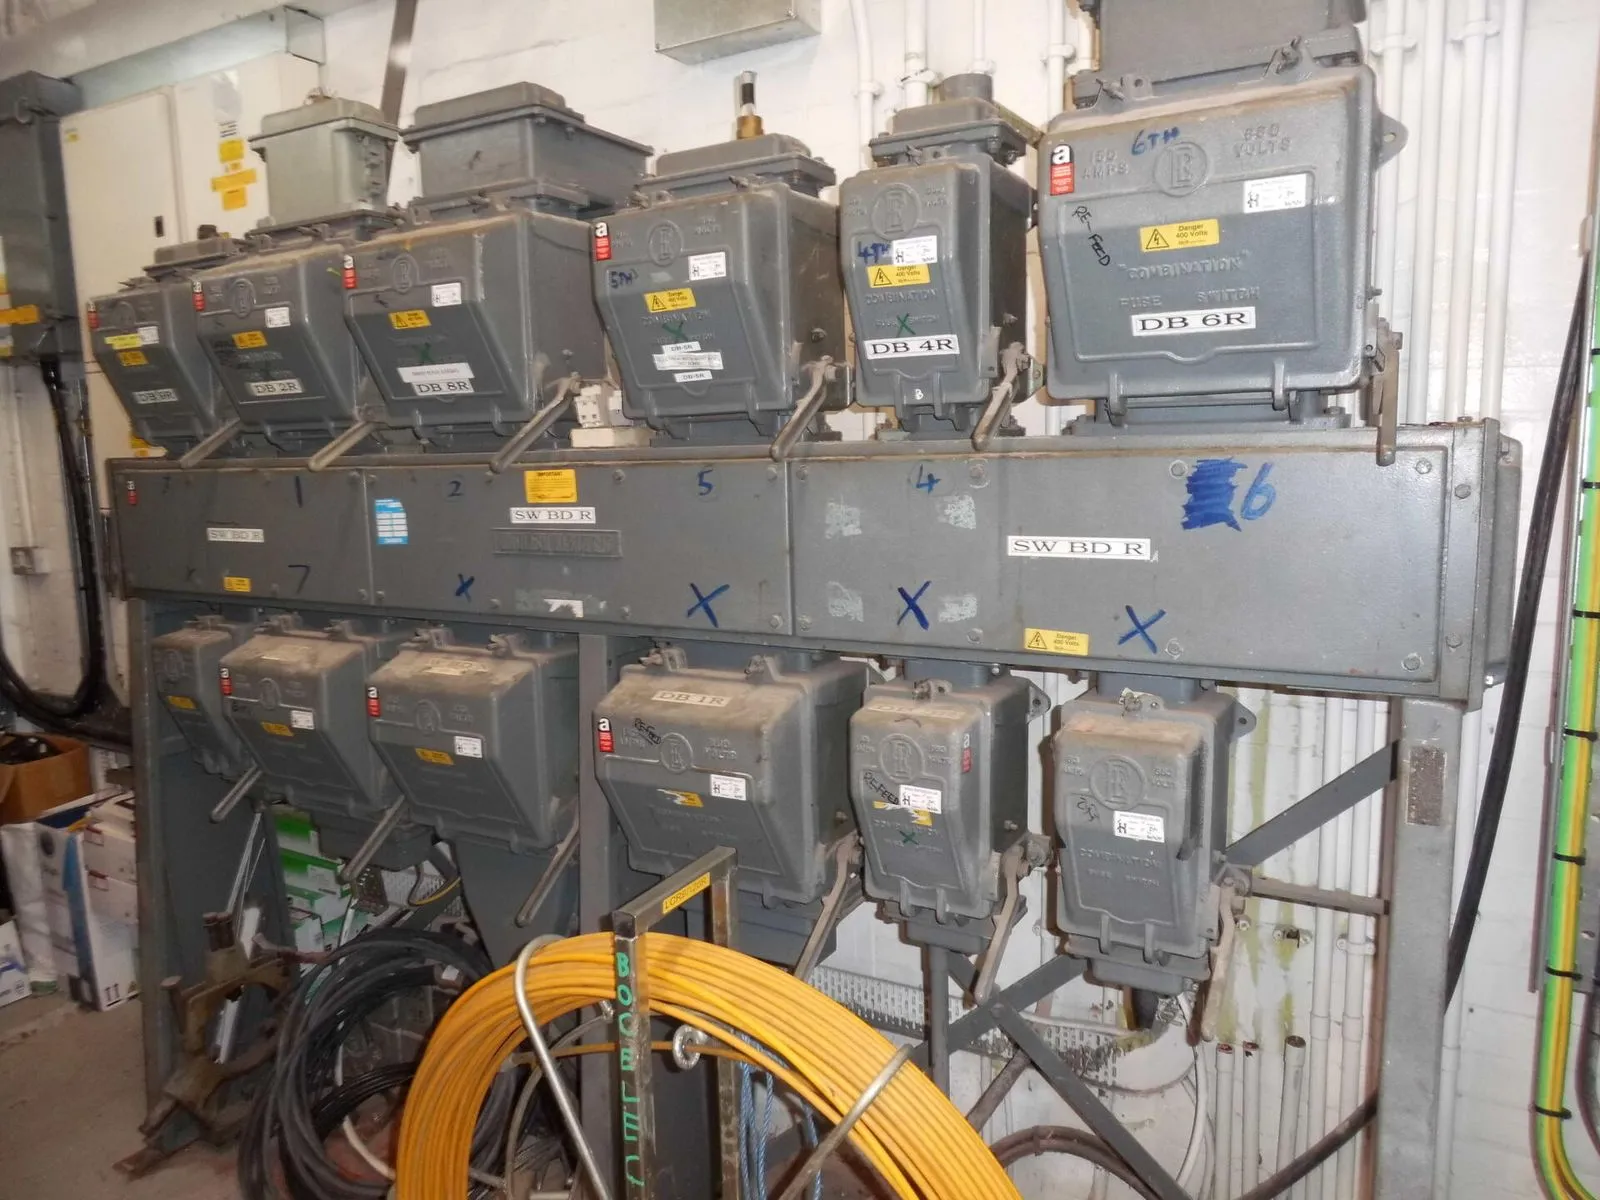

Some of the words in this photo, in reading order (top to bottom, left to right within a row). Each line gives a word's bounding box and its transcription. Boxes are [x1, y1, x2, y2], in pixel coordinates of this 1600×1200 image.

[1178, 223, 1204, 233] Danger
[1139, 316, 1189, 331] DB
[1202, 312, 1248, 327] 6R
[871, 342, 910, 355] DB
[920, 339, 954, 351] 4R
[255, 383, 276, 394] DB
[416, 383, 442, 394] DB
[448, 381, 469, 391] 8R
[698, 469, 714, 496] 5
[916, 464, 942, 495] 4
[448, 480, 464, 498] 2
[1240, 462, 1276, 520] 6
[514, 511, 541, 520] SW
[548, 511, 573, 520] BD
[580, 511, 592, 520] R
[210, 530, 227, 539] SW
[232, 530, 248, 540] BD
[1013, 540, 1057, 552] SW
[1070, 541, 1112, 554] BD
[1125, 543, 1143, 554] R
[660, 692, 690, 701] DB
